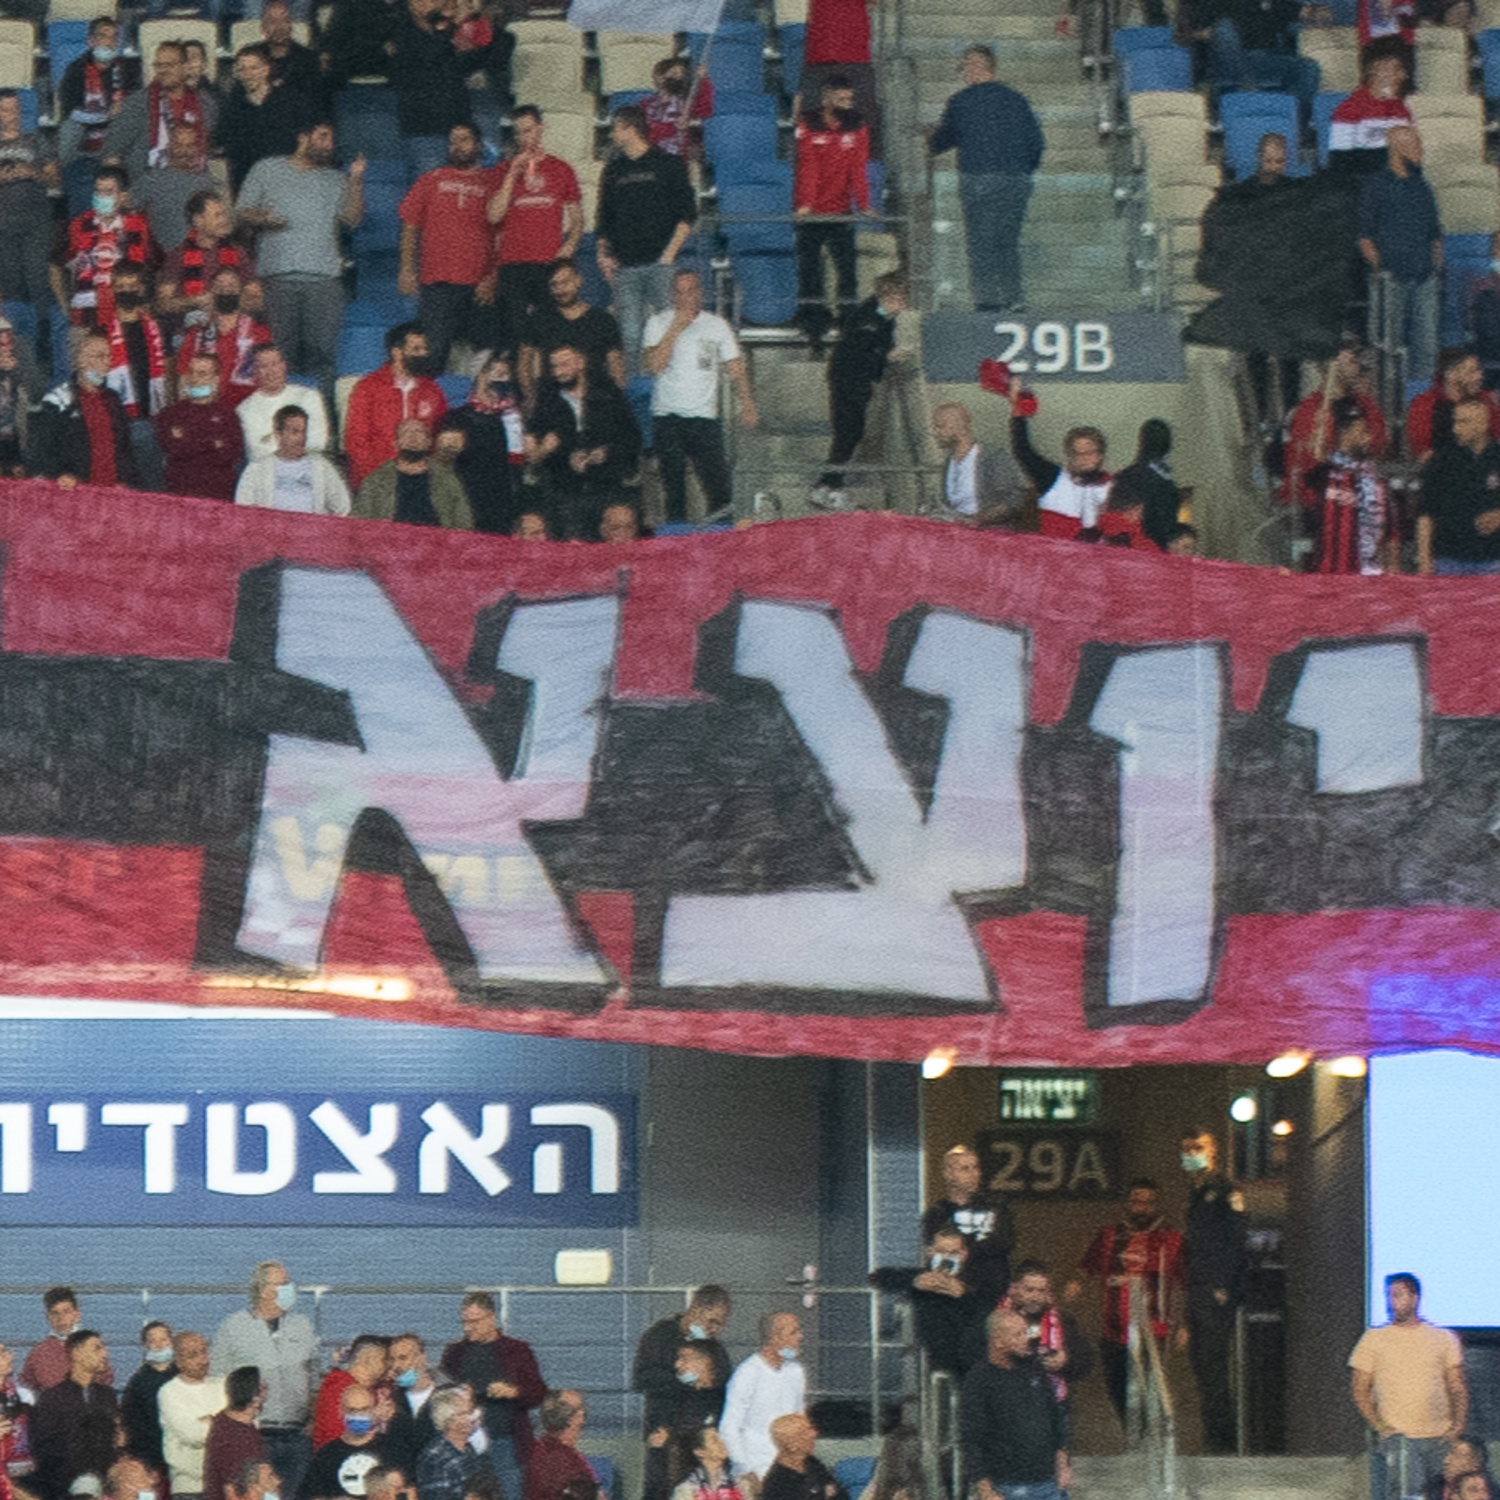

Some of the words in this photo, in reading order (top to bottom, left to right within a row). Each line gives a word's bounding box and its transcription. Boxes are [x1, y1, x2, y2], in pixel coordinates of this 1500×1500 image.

[994, 321, 1115, 374] 29B
[215, 562, 1428, 1012] יוצא
[1001, 1079, 1086, 1118] יציאה
[990, 1141, 1109, 1191] 29A
